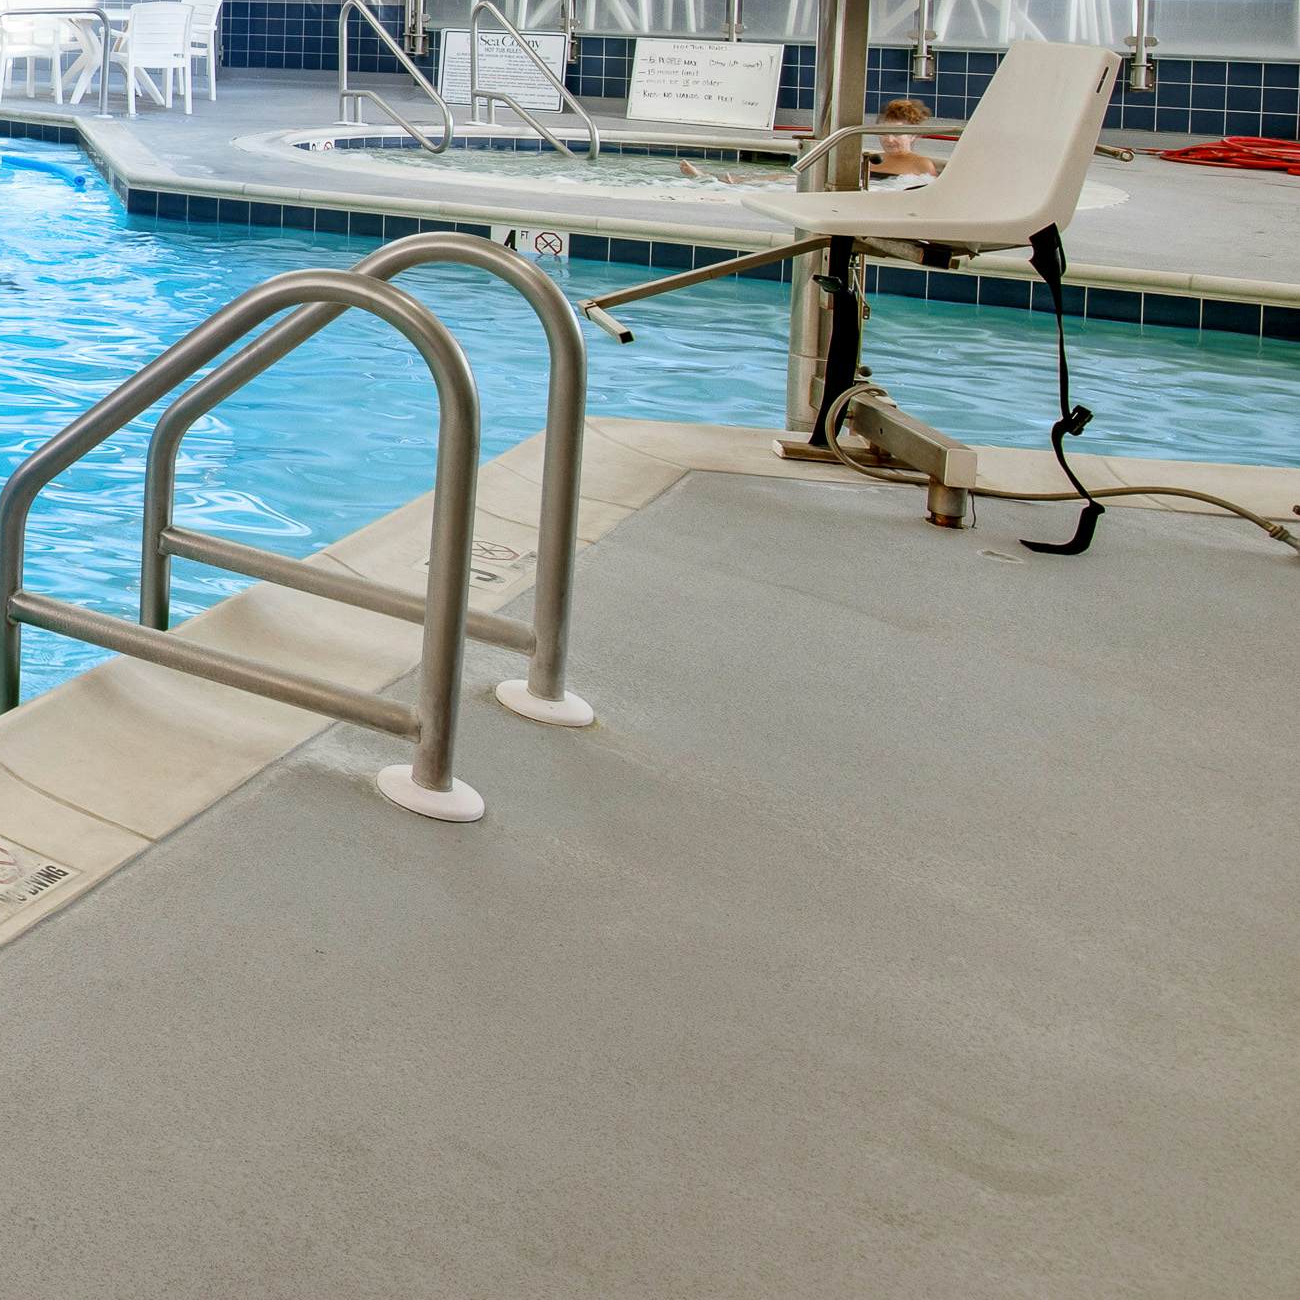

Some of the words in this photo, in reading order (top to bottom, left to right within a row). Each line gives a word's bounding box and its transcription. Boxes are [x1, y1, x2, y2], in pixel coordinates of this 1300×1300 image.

[480, 36, 499, 45] Sea
[502, 36, 541, 51] Cony
[504, 229, 518, 252] 4
[521, 231, 529, 239] FT
